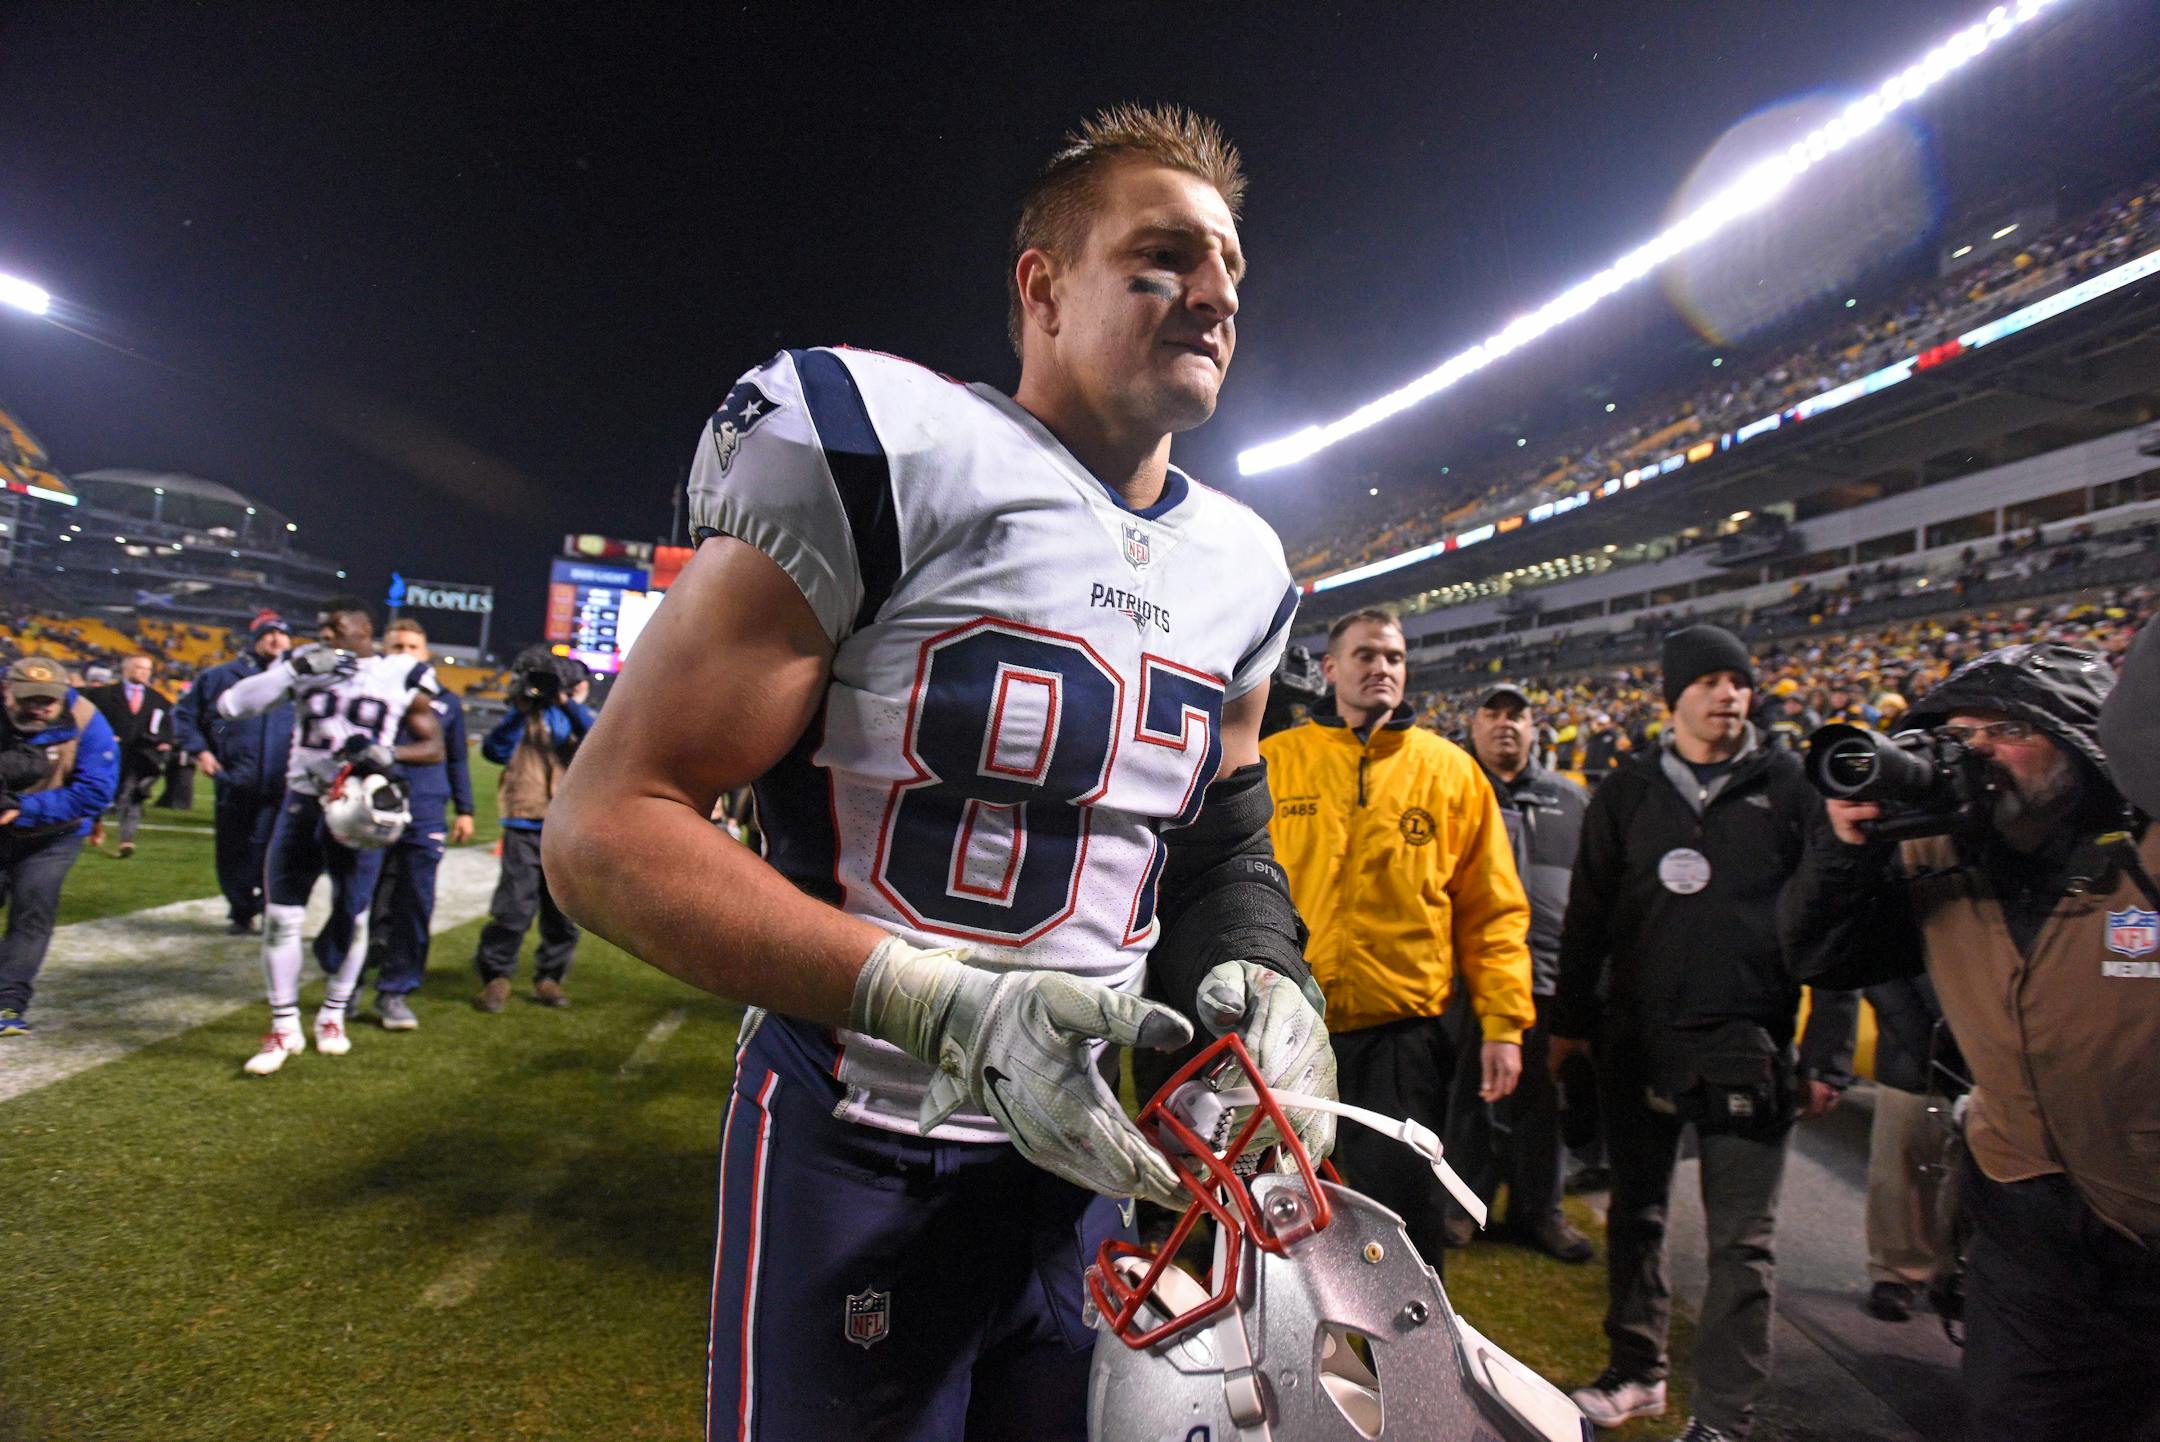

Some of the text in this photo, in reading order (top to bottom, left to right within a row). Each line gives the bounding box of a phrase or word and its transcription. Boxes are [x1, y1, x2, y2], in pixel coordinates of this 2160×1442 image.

[1128, 541, 1148, 562] NFL
[1090, 582, 1171, 634] PATRIOTS
[301, 688, 389, 750] 29
[869, 615, 1226, 948] 87
[2111, 928, 2153, 951] NFL
[852, 1312, 882, 1338] NFL
